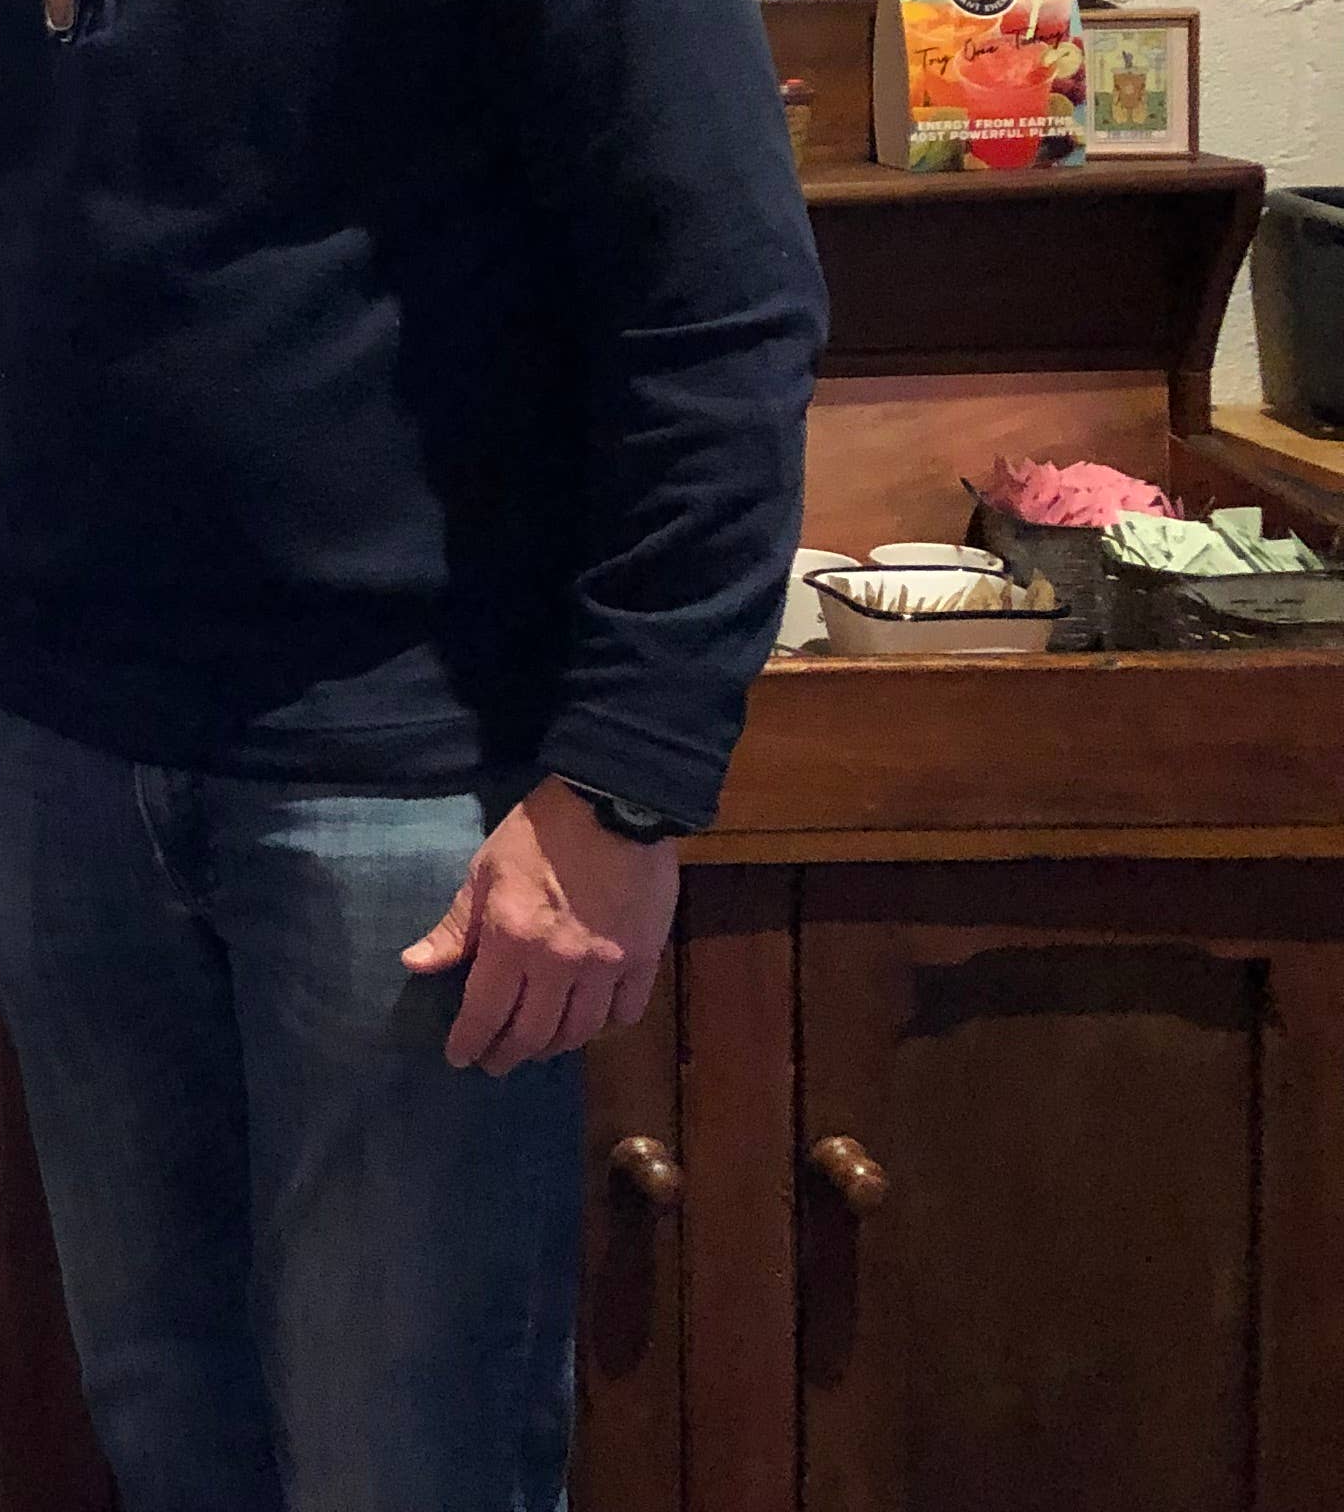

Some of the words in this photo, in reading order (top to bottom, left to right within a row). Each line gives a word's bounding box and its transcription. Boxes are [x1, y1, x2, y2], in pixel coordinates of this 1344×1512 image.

[917, 120, 970, 130] ENERGY
[975, 119, 1014, 128] FROM
[950, 129, 1024, 139] POWERFUL
